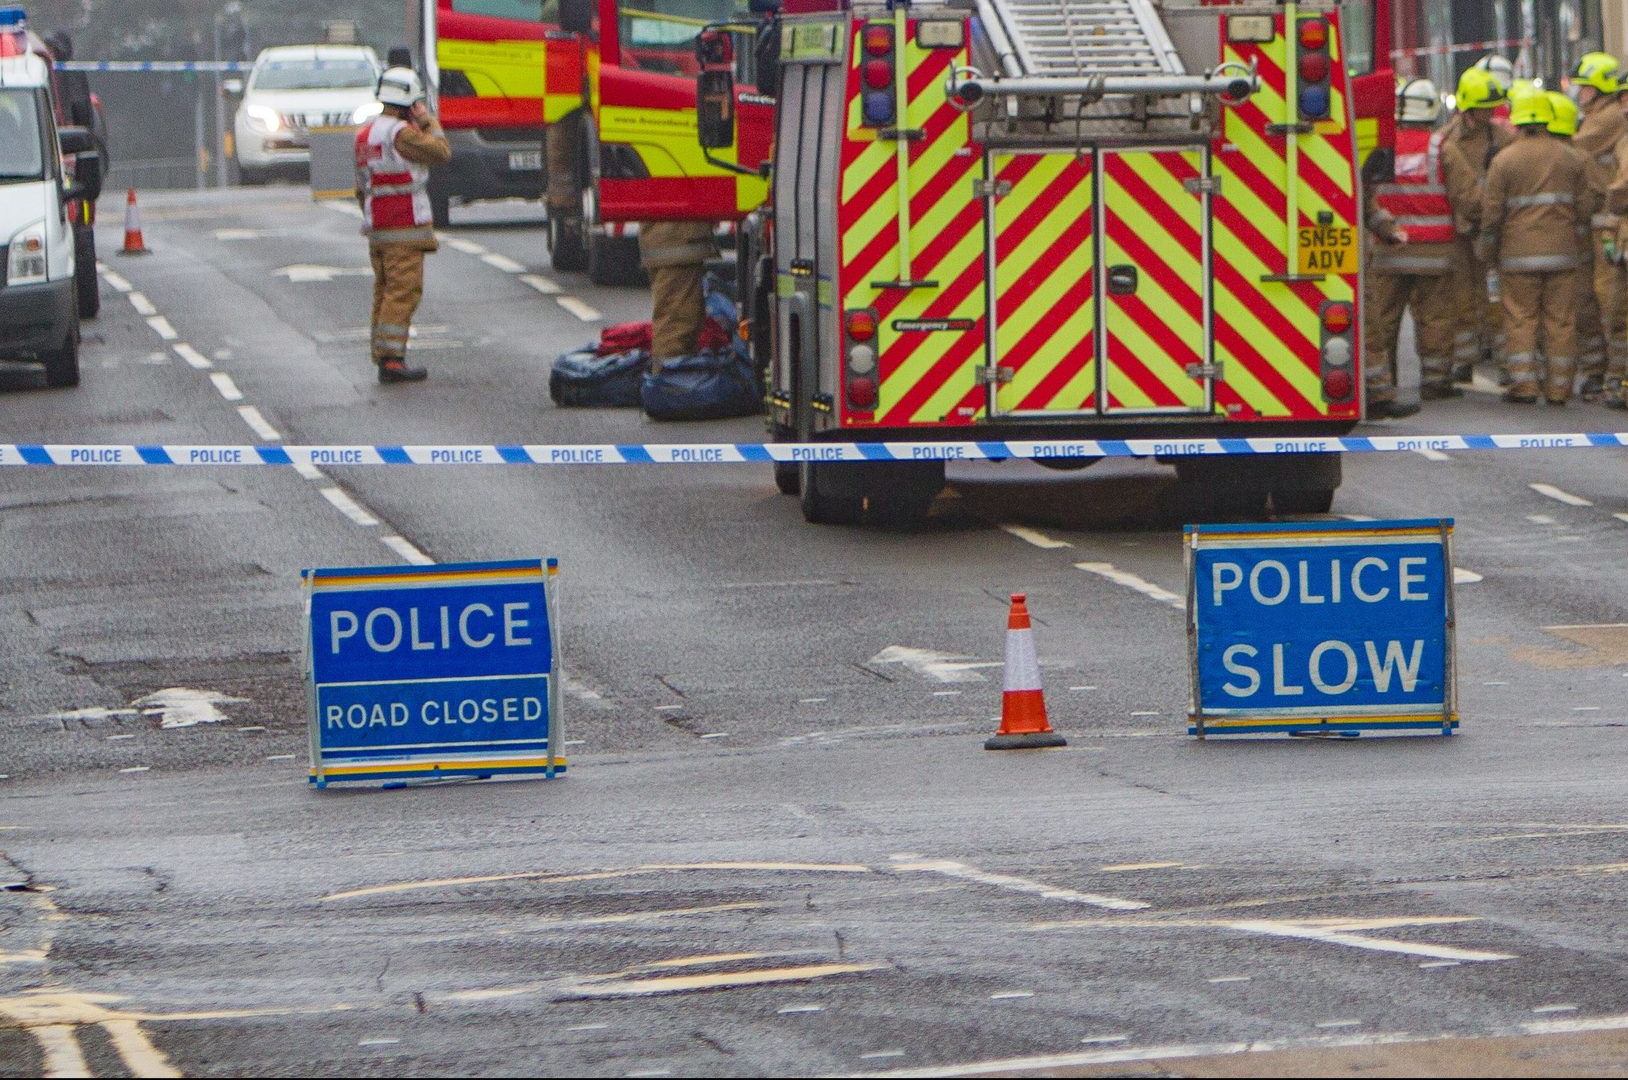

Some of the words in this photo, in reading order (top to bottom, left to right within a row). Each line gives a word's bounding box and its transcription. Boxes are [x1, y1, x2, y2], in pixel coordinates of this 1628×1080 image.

[1299, 228, 1351, 248] SN55
[1308, 250, 1344, 269] ADV
[1033, 445, 1084, 457] POLICE
[1154, 444, 1206, 455] POLICE
[1275, 442, 1326, 454] POLICE
[1397, 440, 1449, 451] POLICE
[71, 449, 121, 462] POLICE
[190, 450, 241, 463] POLICE
[311, 450, 362, 463] POLICE
[431, 450, 482, 462] POLICE
[551, 449, 603, 462] POLICE
[671, 448, 722, 461] POLICE
[792, 447, 843, 460] POLICE
[912, 446, 964, 459] POLICE
[1212, 556, 1429, 606] POLICE
[330, 602, 532, 654] POLICE
[1222, 640, 1425, 698] SLOW
[327, 703, 409, 729] ROAD
[421, 697, 541, 726] CLOSED
